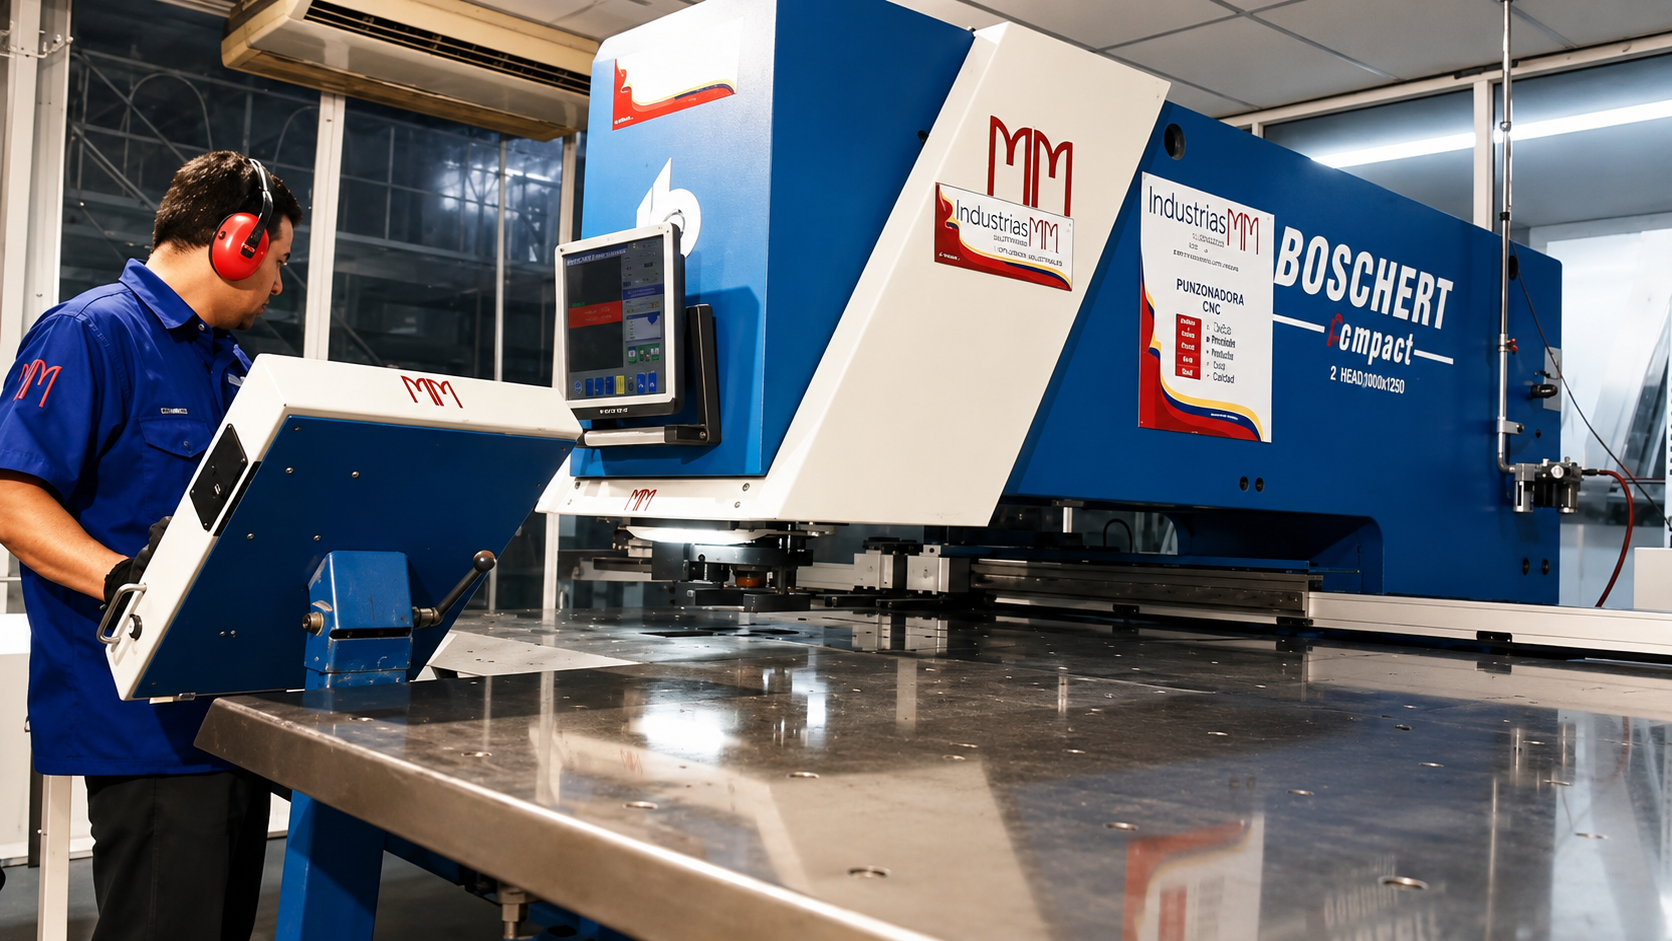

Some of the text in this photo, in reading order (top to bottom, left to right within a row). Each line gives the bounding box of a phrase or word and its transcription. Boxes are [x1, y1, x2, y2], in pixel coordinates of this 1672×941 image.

[987, 115, 1073, 217] MM
[1176, 278, 1245, 306] PUNZONADORA
[1274, 226, 1454, 330] BOSCHERT
[1202, 300, 1221, 315] CNC
[1330, 365, 1337, 381] 2
[400, 375, 464, 409] MM
[623, 488, 658, 511] MM
